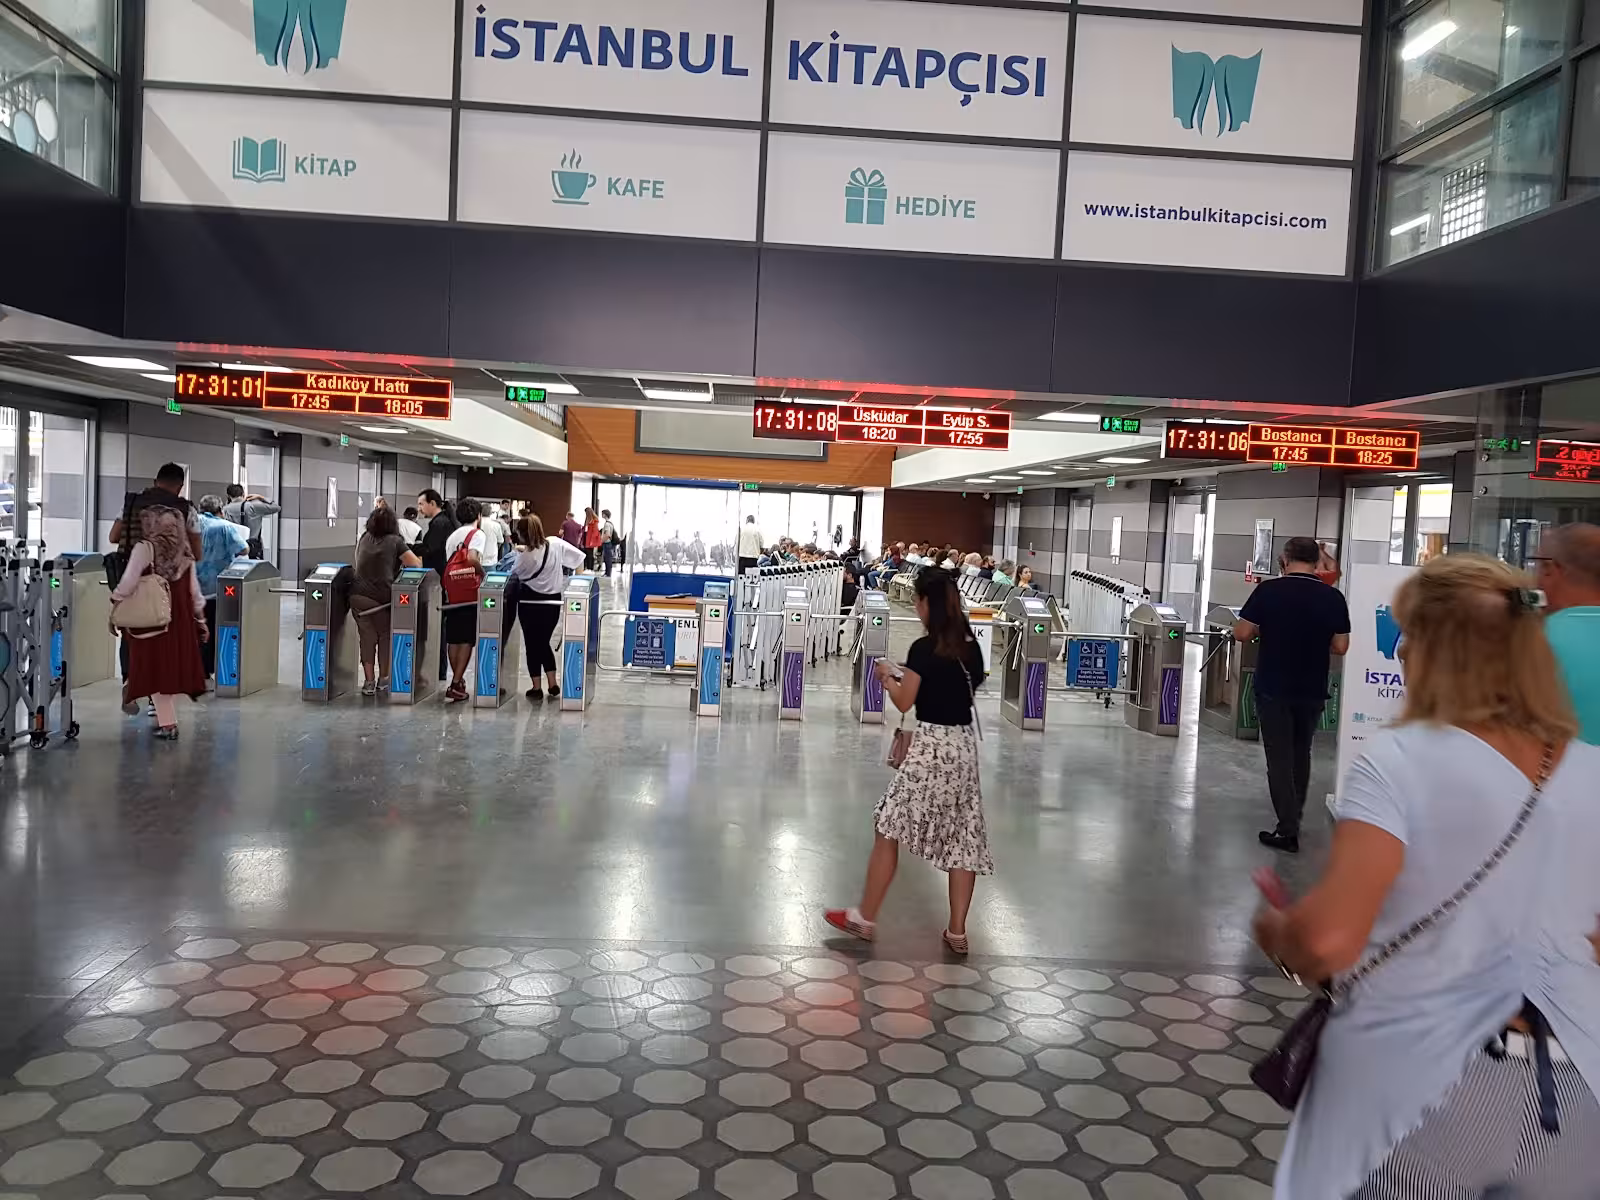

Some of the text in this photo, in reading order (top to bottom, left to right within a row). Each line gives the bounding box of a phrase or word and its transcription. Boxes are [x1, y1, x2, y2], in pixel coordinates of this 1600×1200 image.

[474, 4, 1047, 107] İSTANBUL KİTAPÇISI
[295, 153, 357, 177] KİTAP
[607, 177, 665, 199] KAFE
[895, 194, 976, 219] HEDİYE
[1084, 203, 1327, 229] www.istanbulkitapcisi.com
[176, 373, 262, 398] 17:31:01
[306, 373, 409, 394] Kadıköy Hattı
[291, 394, 330, 409] 17:45
[384, 399, 423, 415] 18:05
[755, 408, 837, 432] 17:31:08
[853, 406, 909, 425] Üsküdar
[942, 413, 990, 429] Eyüp S.
[862, 427, 897, 441] 18:20
[948, 431, 984, 445] 17:55
[1168, 429, 1248, 451] 17:31:06
[1261, 428, 1322, 443] Bostancı
[1346, 431, 1406, 447] Bostancı
[1272, 446, 1308, 461] 17:45
[1357, 450, 1393, 465] 18:25
[1365, 668, 1406, 686] İSTA
[1377, 687, 1405, 699] KİTA
